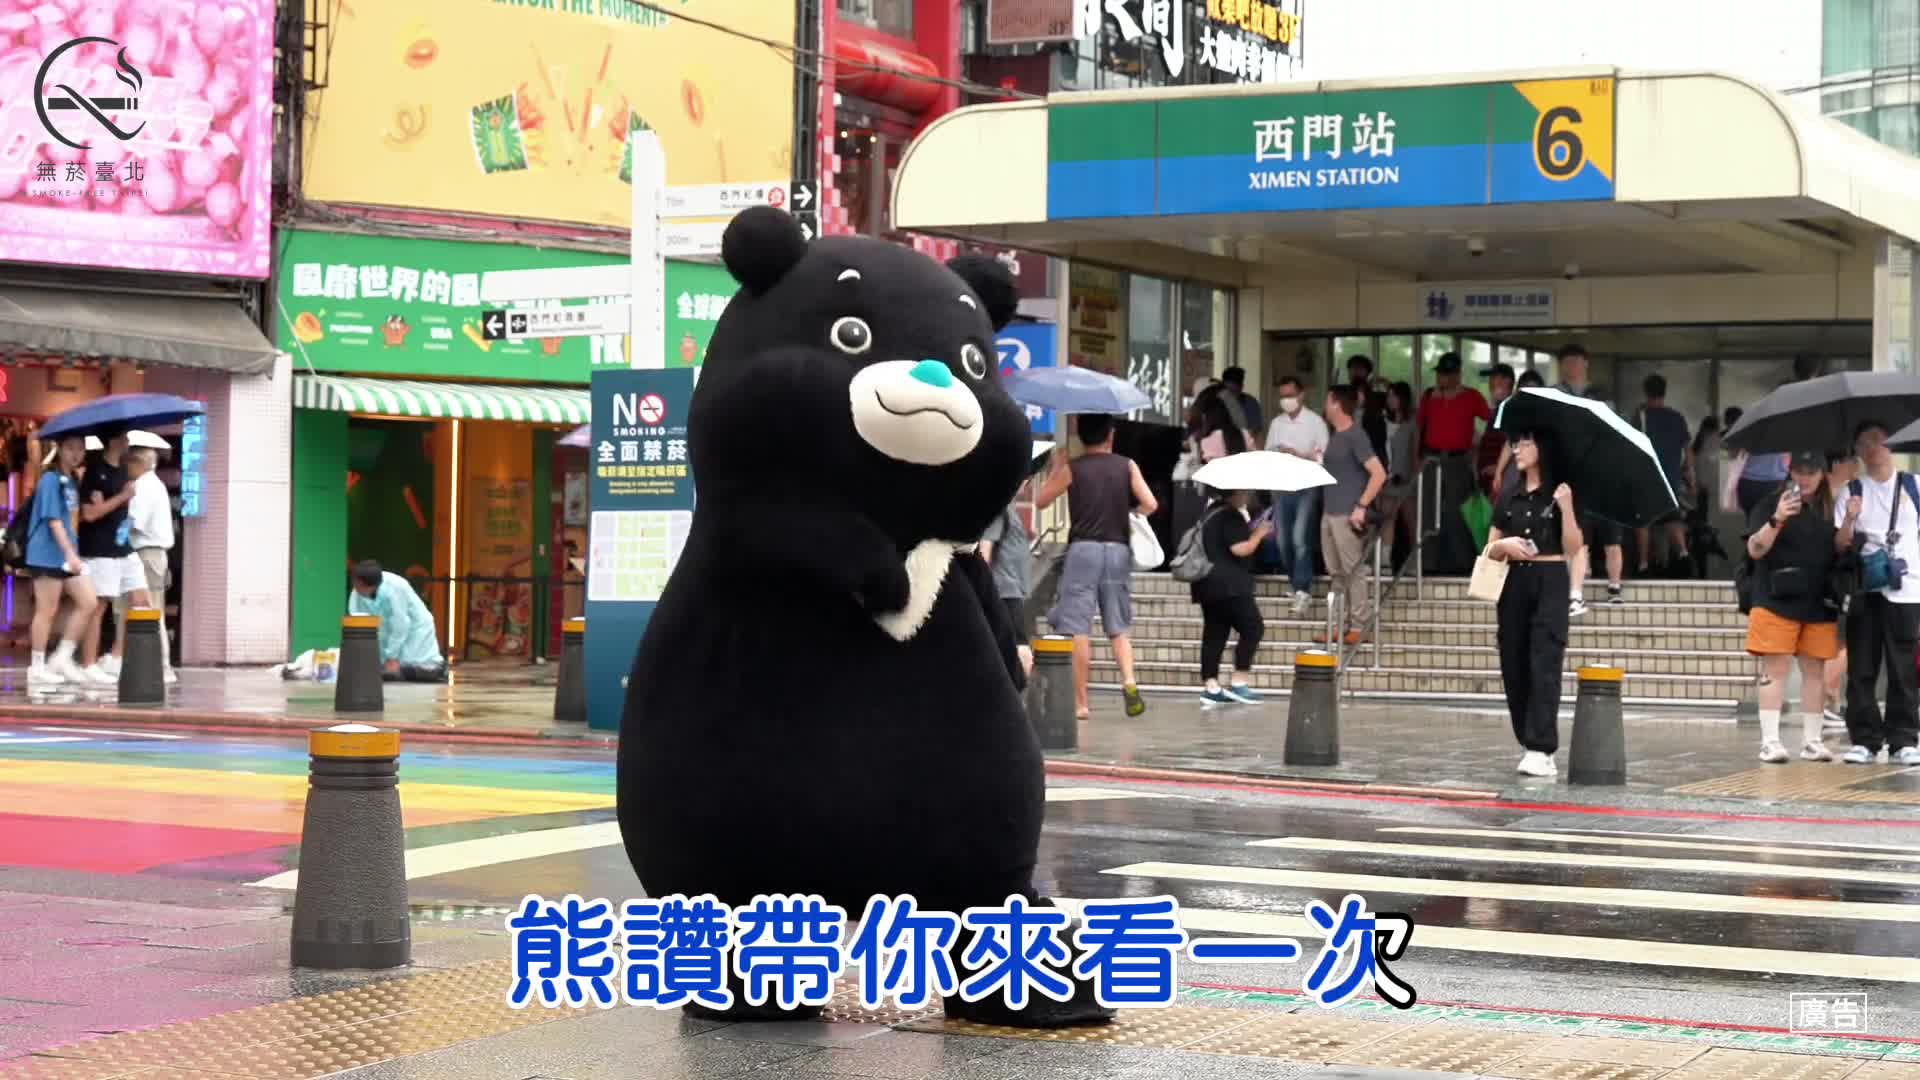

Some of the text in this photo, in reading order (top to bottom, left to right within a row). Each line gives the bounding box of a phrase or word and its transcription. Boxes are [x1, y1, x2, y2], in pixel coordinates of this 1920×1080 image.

[1252, 111, 1396, 163] 西門站
[1537, 106, 1583, 176] 6
[1249, 166, 1400, 189] XIMEN STATION
[613, 427, 666, 437] SMOKING
[597, 440, 687, 463] 全面禁菸
